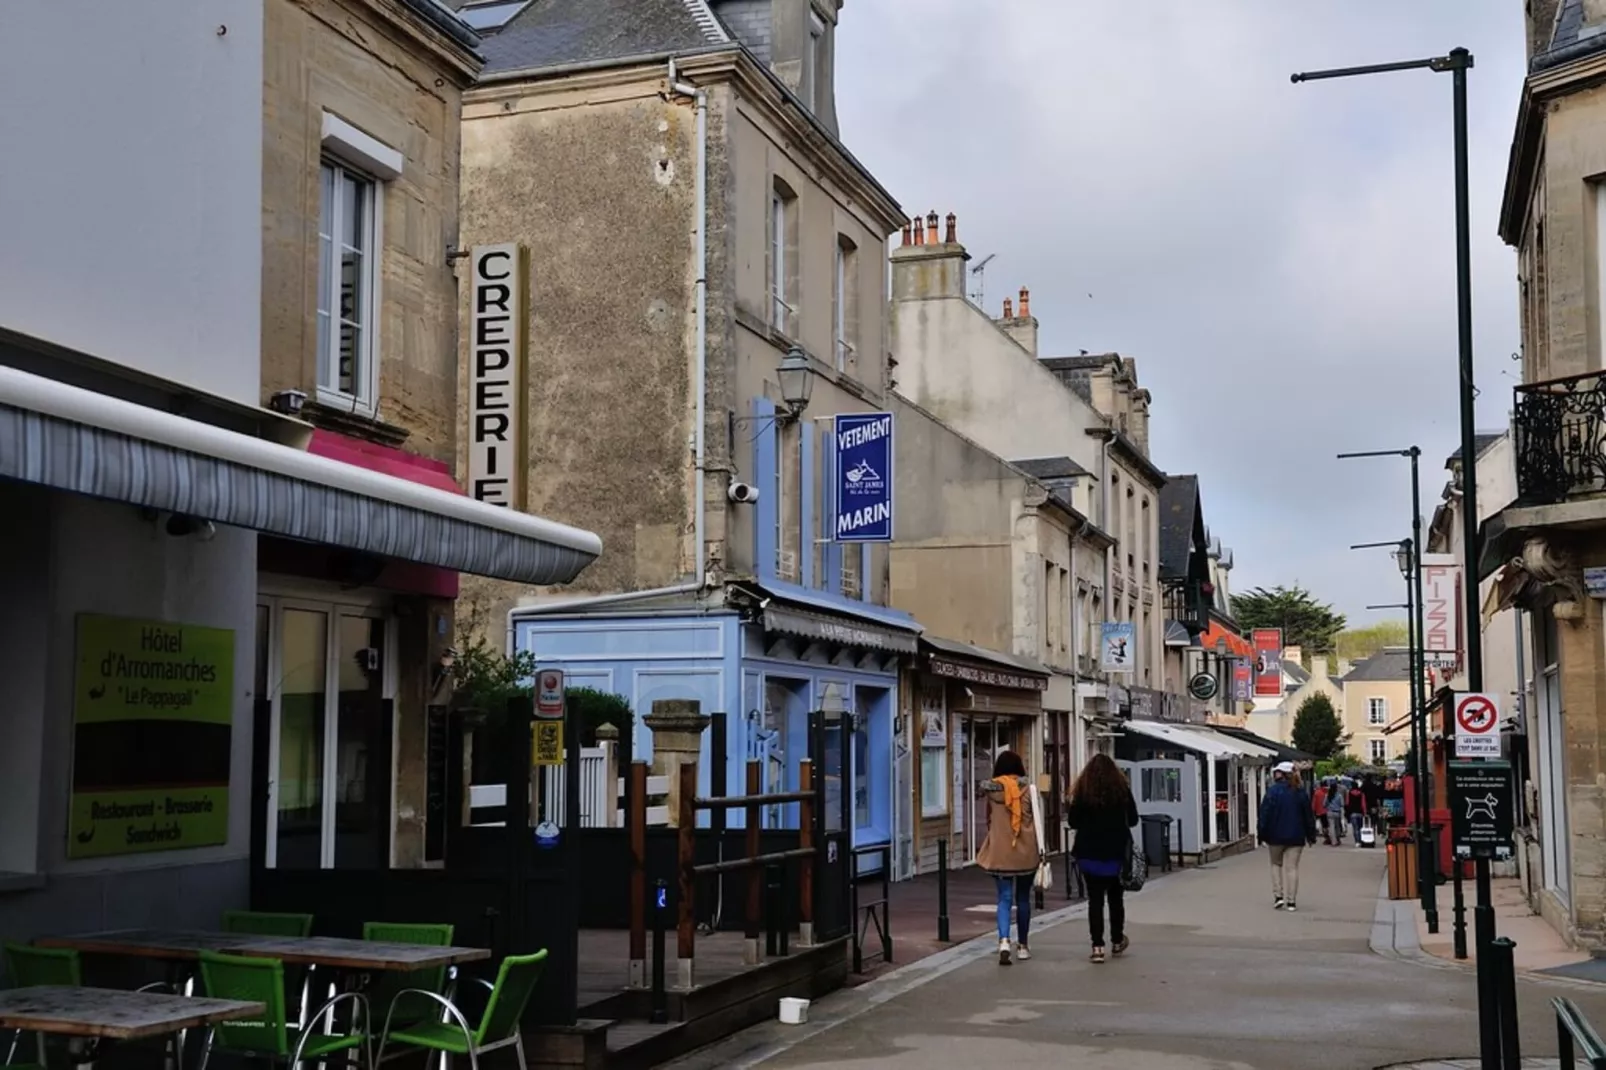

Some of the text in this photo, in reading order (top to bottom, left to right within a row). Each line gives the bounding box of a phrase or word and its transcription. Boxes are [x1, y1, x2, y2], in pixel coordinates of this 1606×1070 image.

[475, 251, 511, 509] CREPERIE
[838, 417, 891, 451] VETEMENT
[838, 500, 890, 533] MARIN
[141, 626, 183, 654] Hôtel
[101, 650, 216, 683] d'Arromanches
[91, 799, 155, 820] Restaurant
[165, 795, 213, 815] Brasserie
[126, 821, 182, 845] Sandwich
